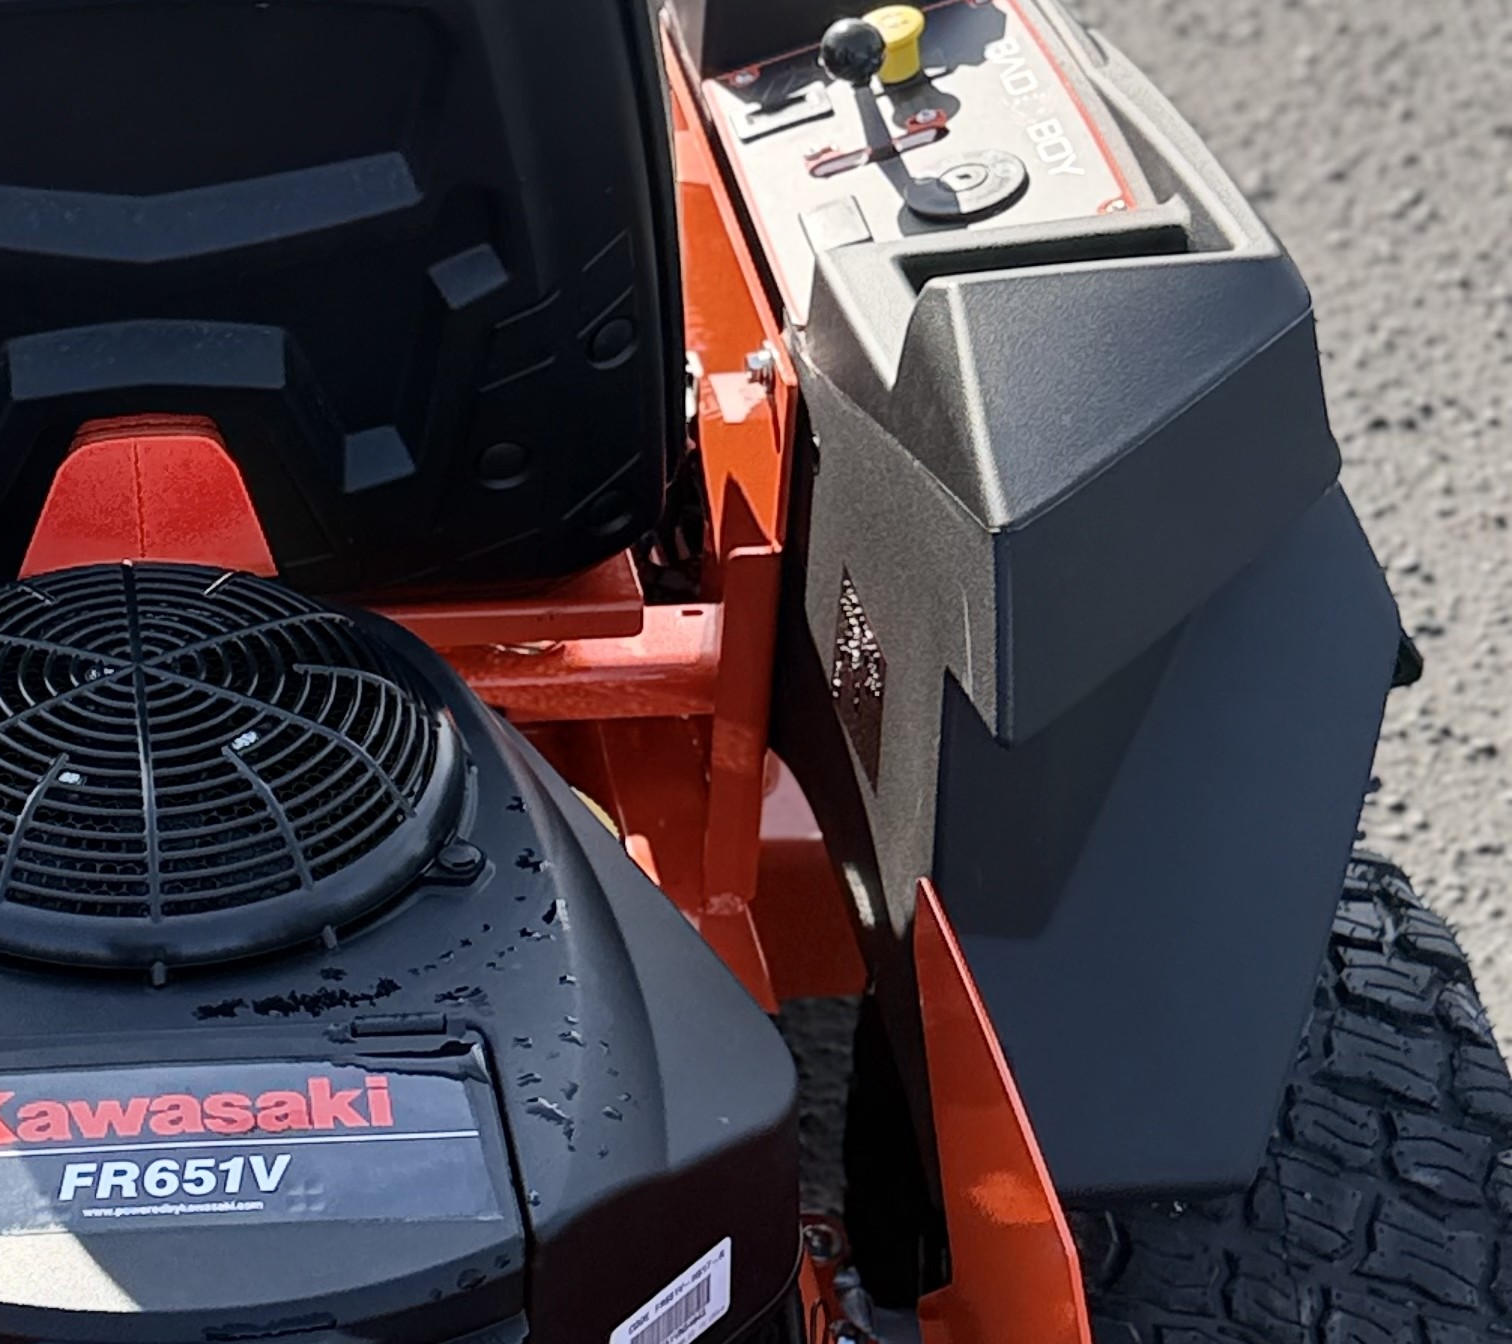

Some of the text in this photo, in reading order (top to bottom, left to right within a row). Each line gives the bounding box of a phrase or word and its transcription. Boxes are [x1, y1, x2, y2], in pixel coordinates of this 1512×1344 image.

[984, 35, 1085, 175] BAD BOY
[58, 1153, 291, 1202] FR651V
